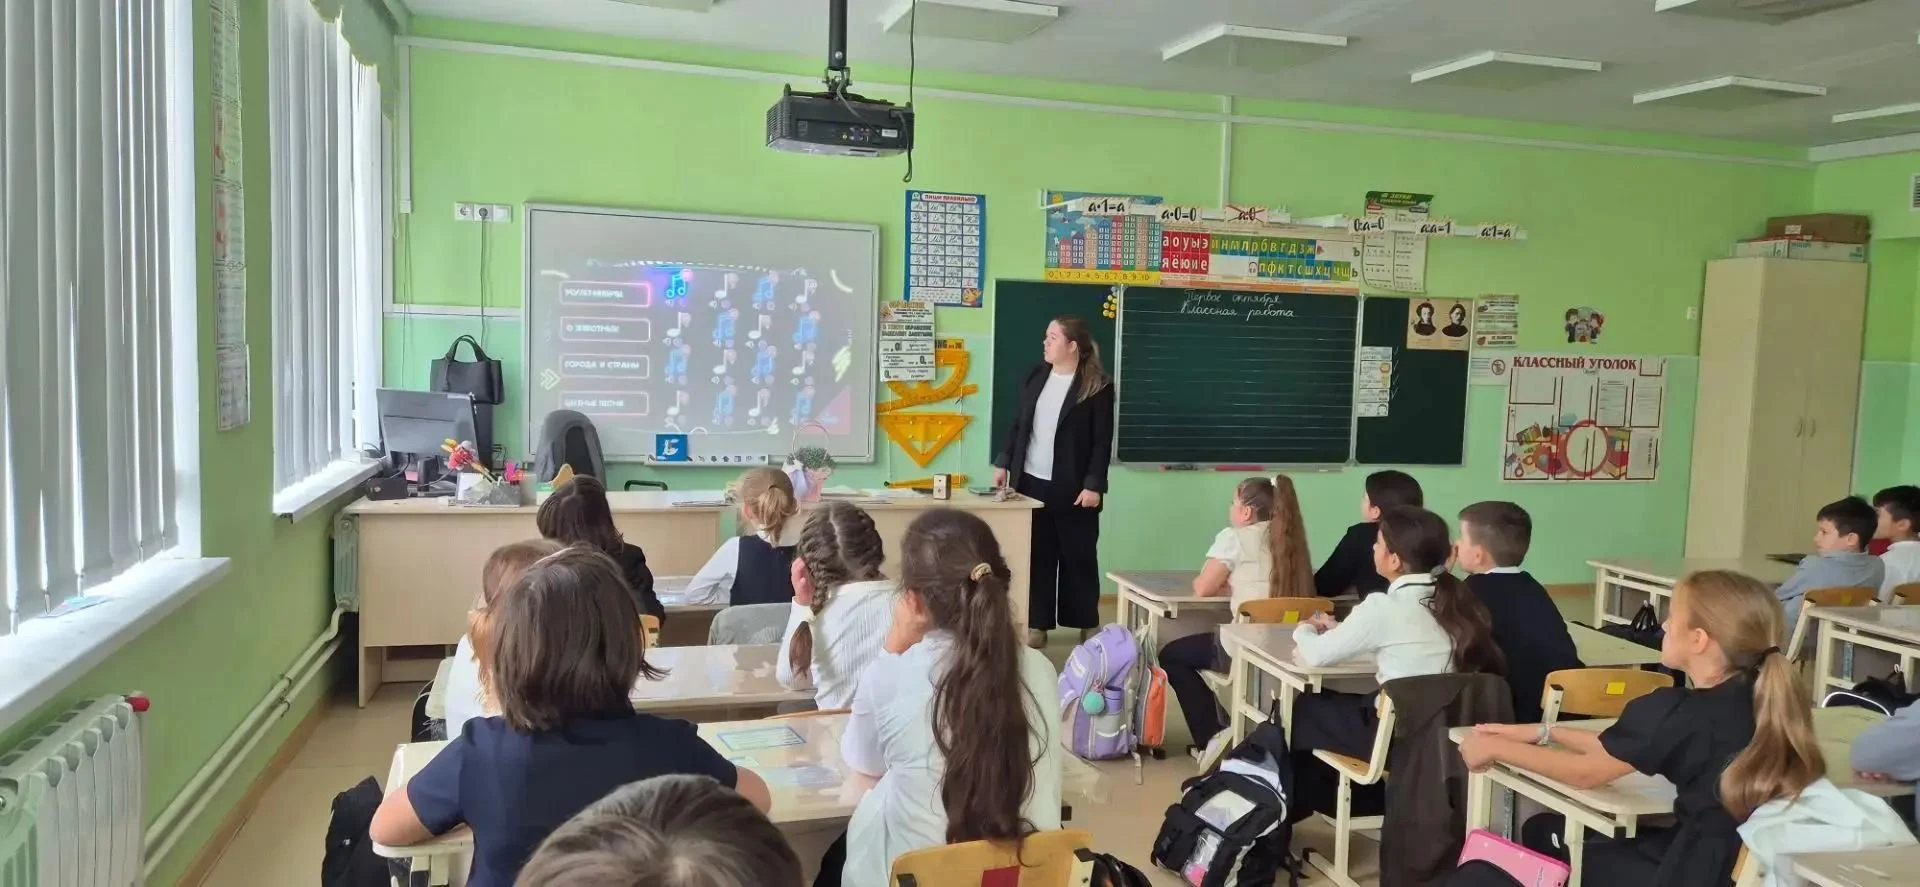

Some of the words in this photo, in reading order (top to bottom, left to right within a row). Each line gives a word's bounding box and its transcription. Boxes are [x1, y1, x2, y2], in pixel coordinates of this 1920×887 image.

[564, 360, 597, 368] ГОРОДА
[607, 361, 639, 369] СТРАНЫ
[1513, 356, 1585, 369] КЛАССНЫЙ
[1589, 358, 1637, 370] УГОЛОК
